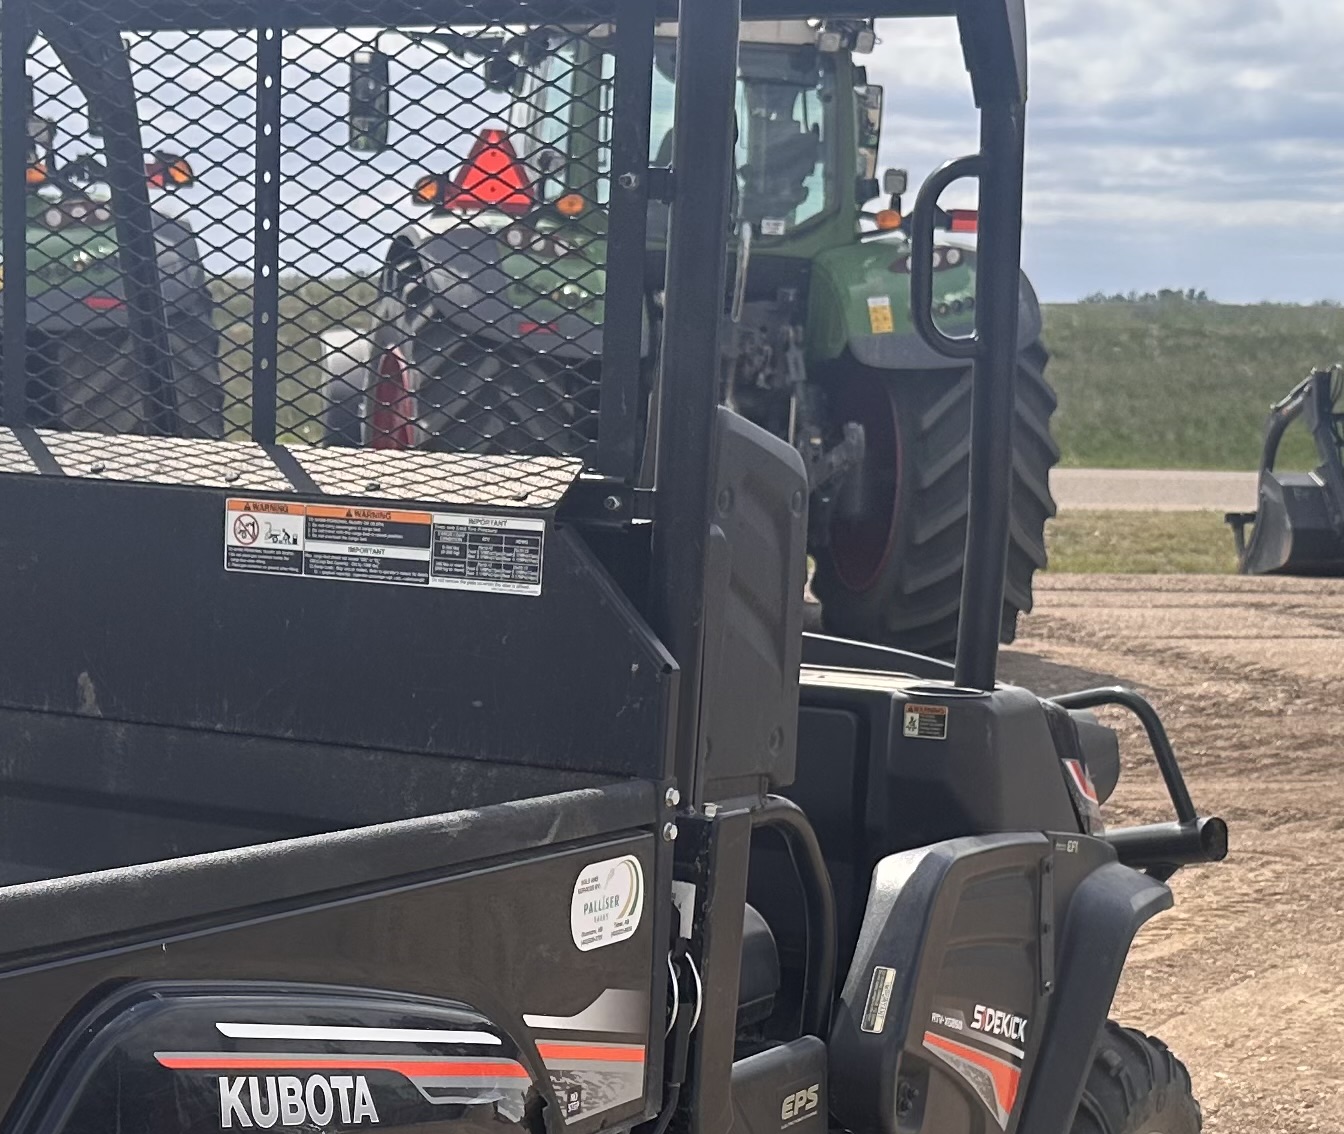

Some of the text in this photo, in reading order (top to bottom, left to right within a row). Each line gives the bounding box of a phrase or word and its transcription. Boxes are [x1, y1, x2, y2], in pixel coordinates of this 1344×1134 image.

[354, 509, 392, 520] WARNING
[468, 517, 508, 528] IMPORTANT
[347, 546, 386, 556] IMPORTANT
[583, 894, 620, 916] PALLISER
[970, 1004, 1027, 1042] SIDEKICK
[218, 1074, 380, 1129] KUBOTA
[781, 1083, 820, 1120] EPS
